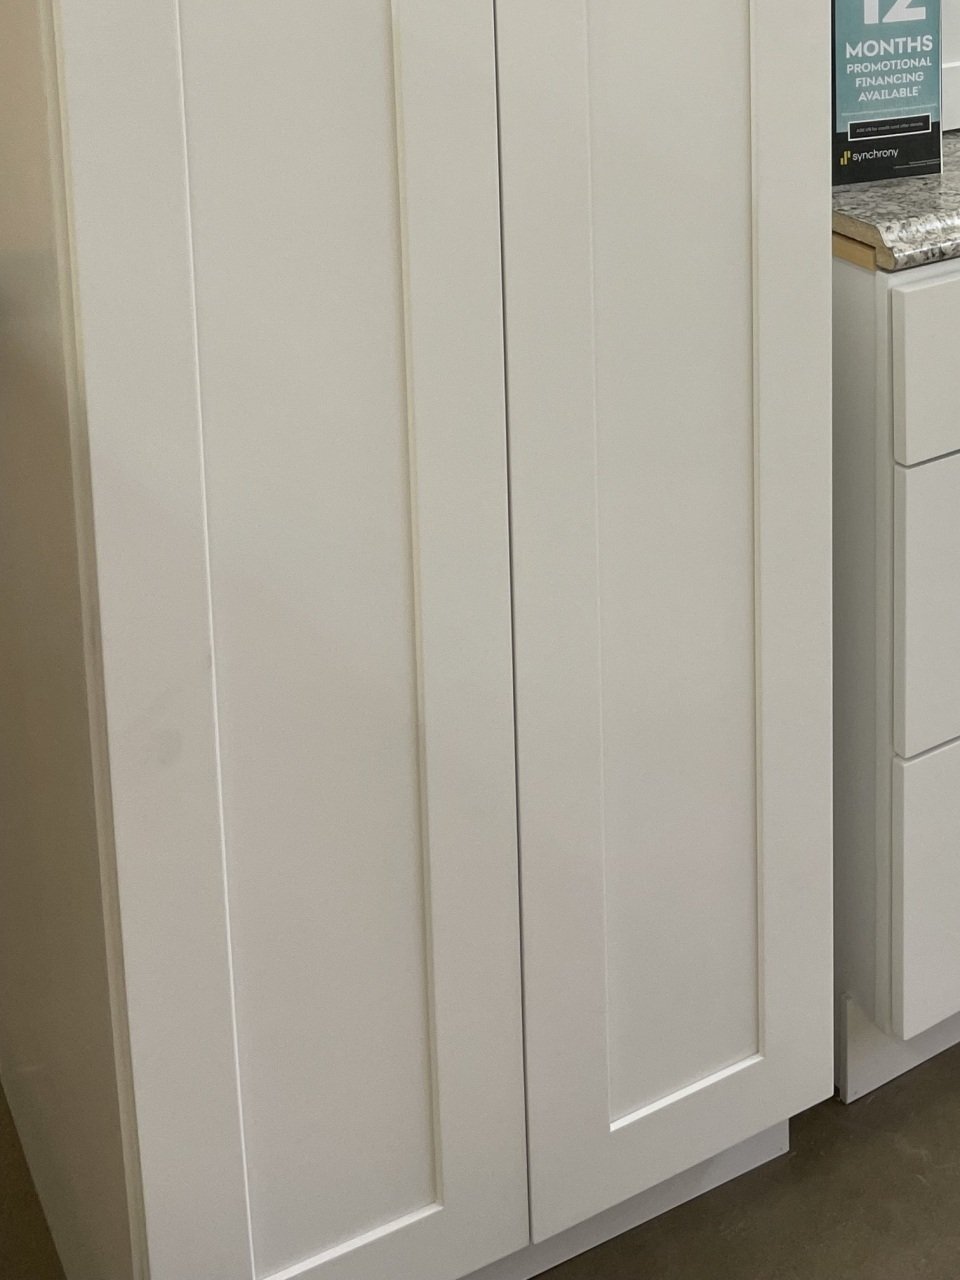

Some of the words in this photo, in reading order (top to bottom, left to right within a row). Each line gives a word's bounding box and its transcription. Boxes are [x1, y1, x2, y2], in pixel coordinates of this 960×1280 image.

[846, 35, 933, 59] MONTHS
[846, 57, 932, 74] PROMOTIONAL
[855, 71, 924, 88] FINANCING
[852, 148, 899, 162] synchrony
